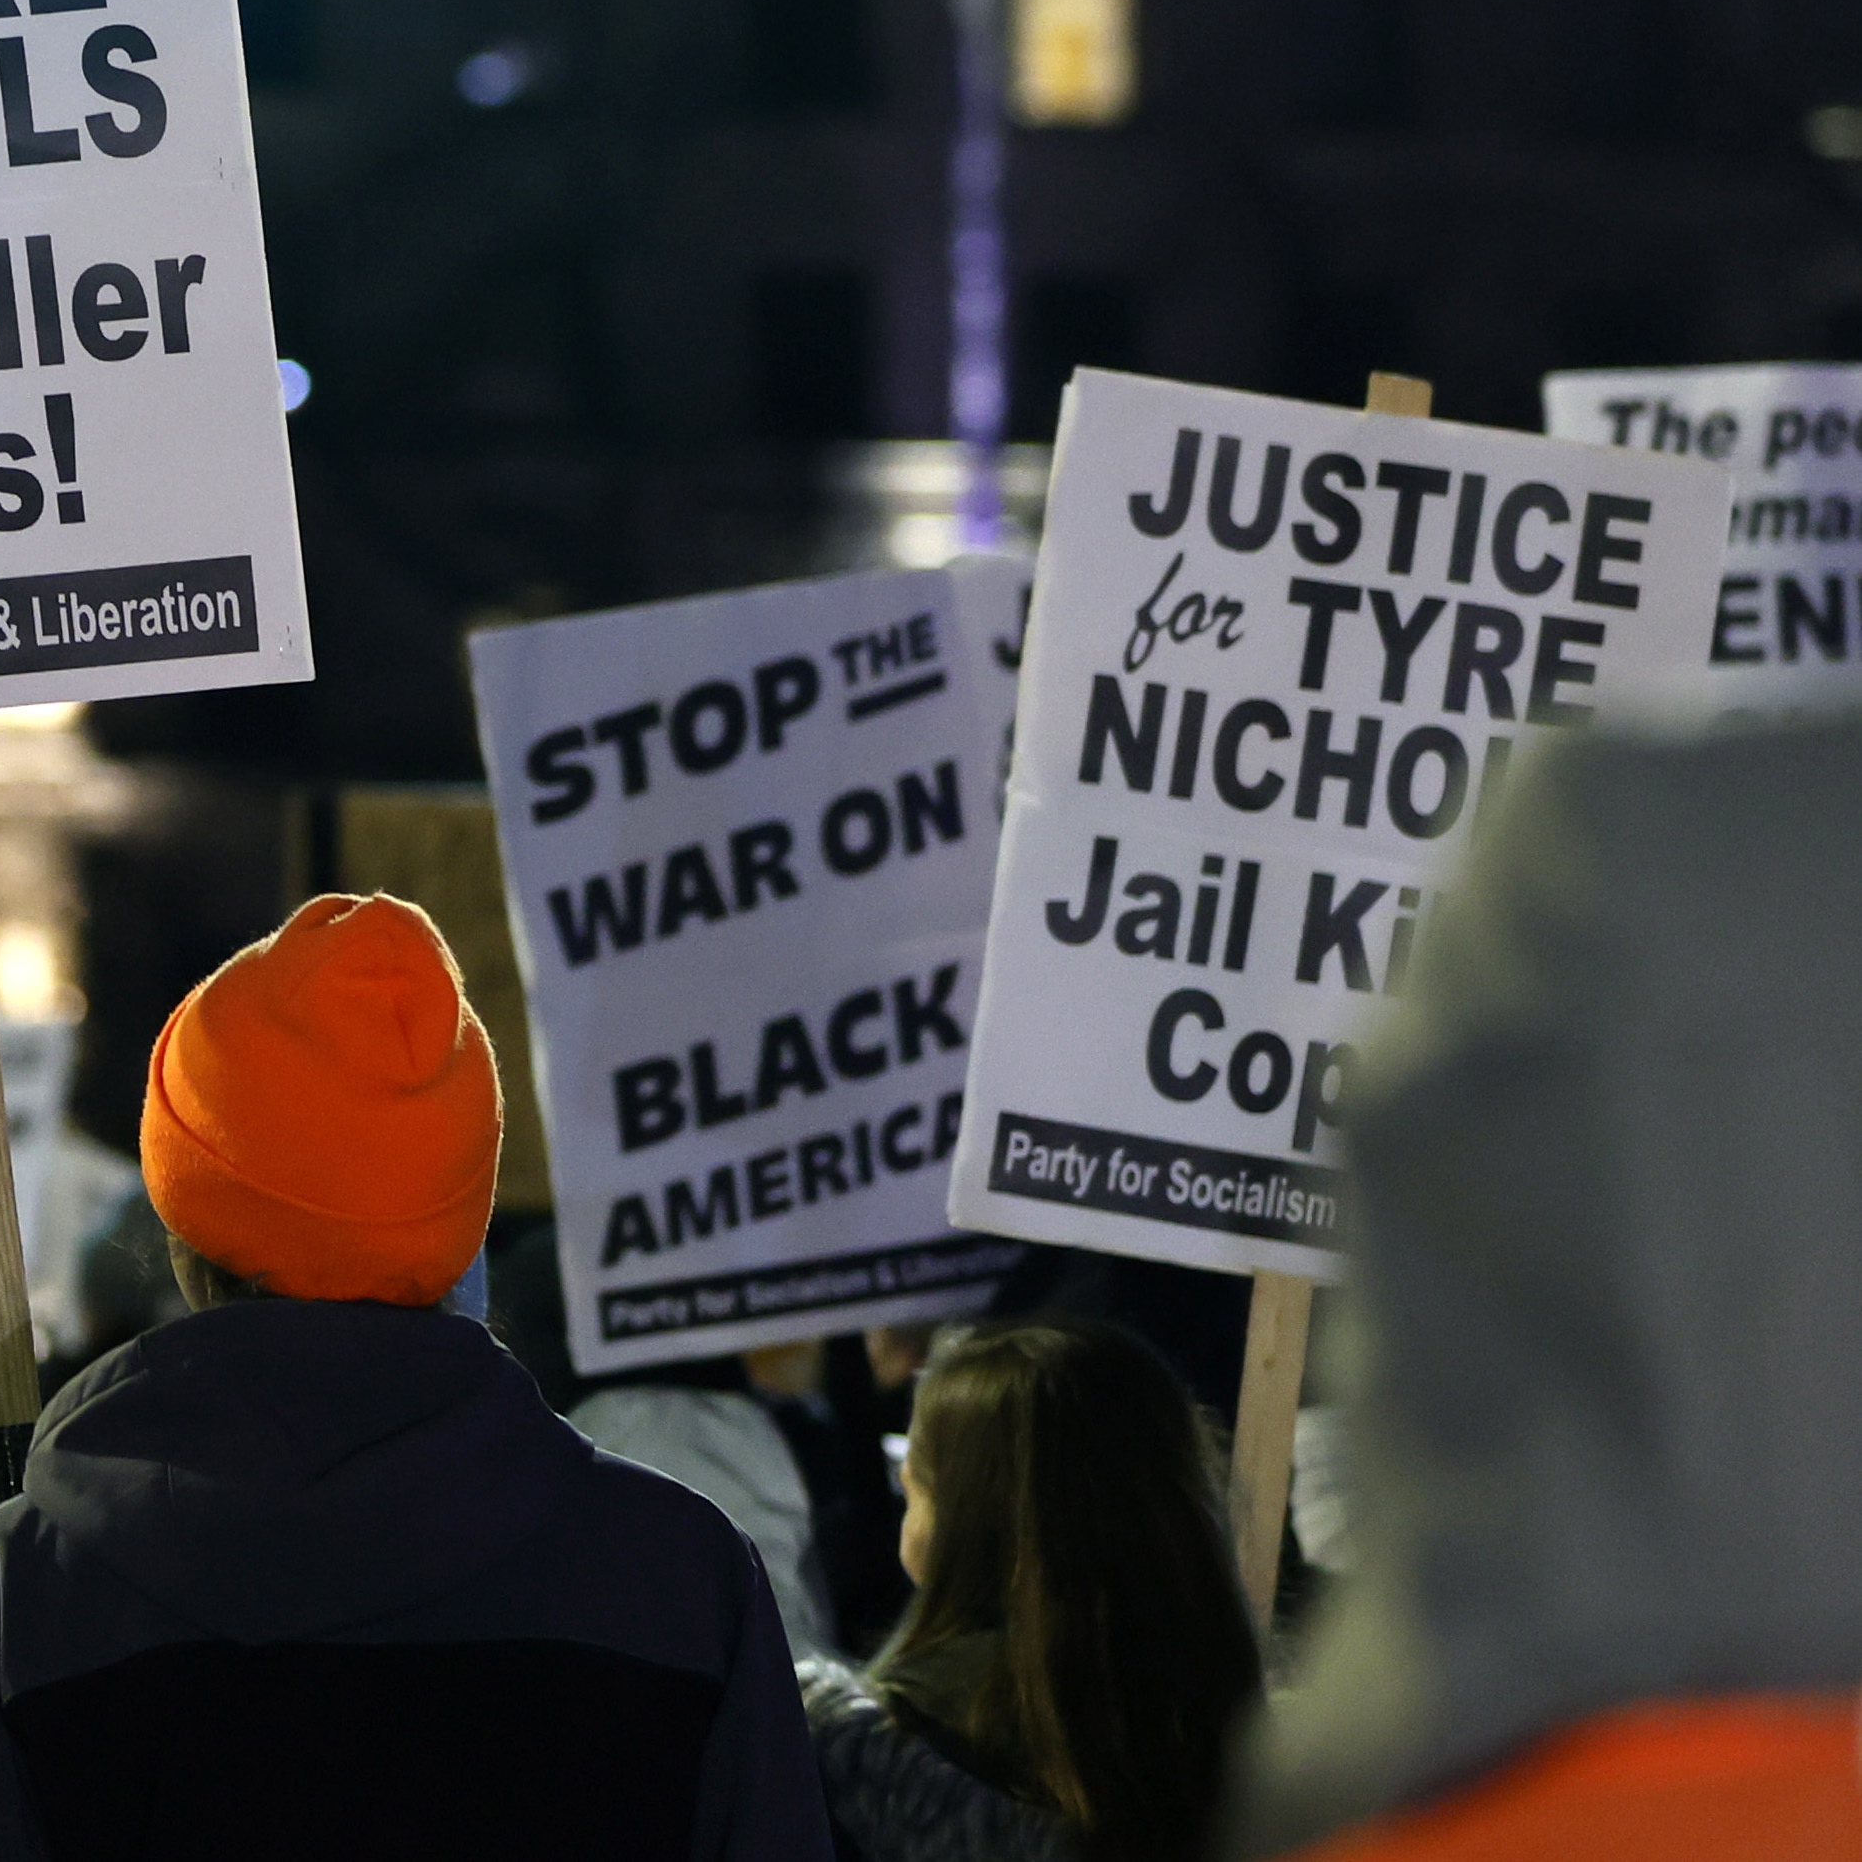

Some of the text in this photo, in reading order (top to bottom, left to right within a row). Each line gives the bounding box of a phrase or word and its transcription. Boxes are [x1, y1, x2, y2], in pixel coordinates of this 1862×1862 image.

[1601, 396, 1738, 461] The
[1128, 427, 1653, 610] JUSTICE
[31, 583, 241, 647] Liberation
[1122, 552, 1244, 672] for
[1287, 577, 1606, 728] TYRE
[1709, 574, 1862, 665] EN
[524, 654, 820, 826] STOP
[831, 611, 937, 686] THE
[547, 820, 800, 970] WAR
[820, 758, 965, 878] ON
[1044, 835, 1440, 996] Jail Ki
[613, 961, 967, 1152] BLACK
[1005, 1131, 1338, 1230] Party for Socialism
